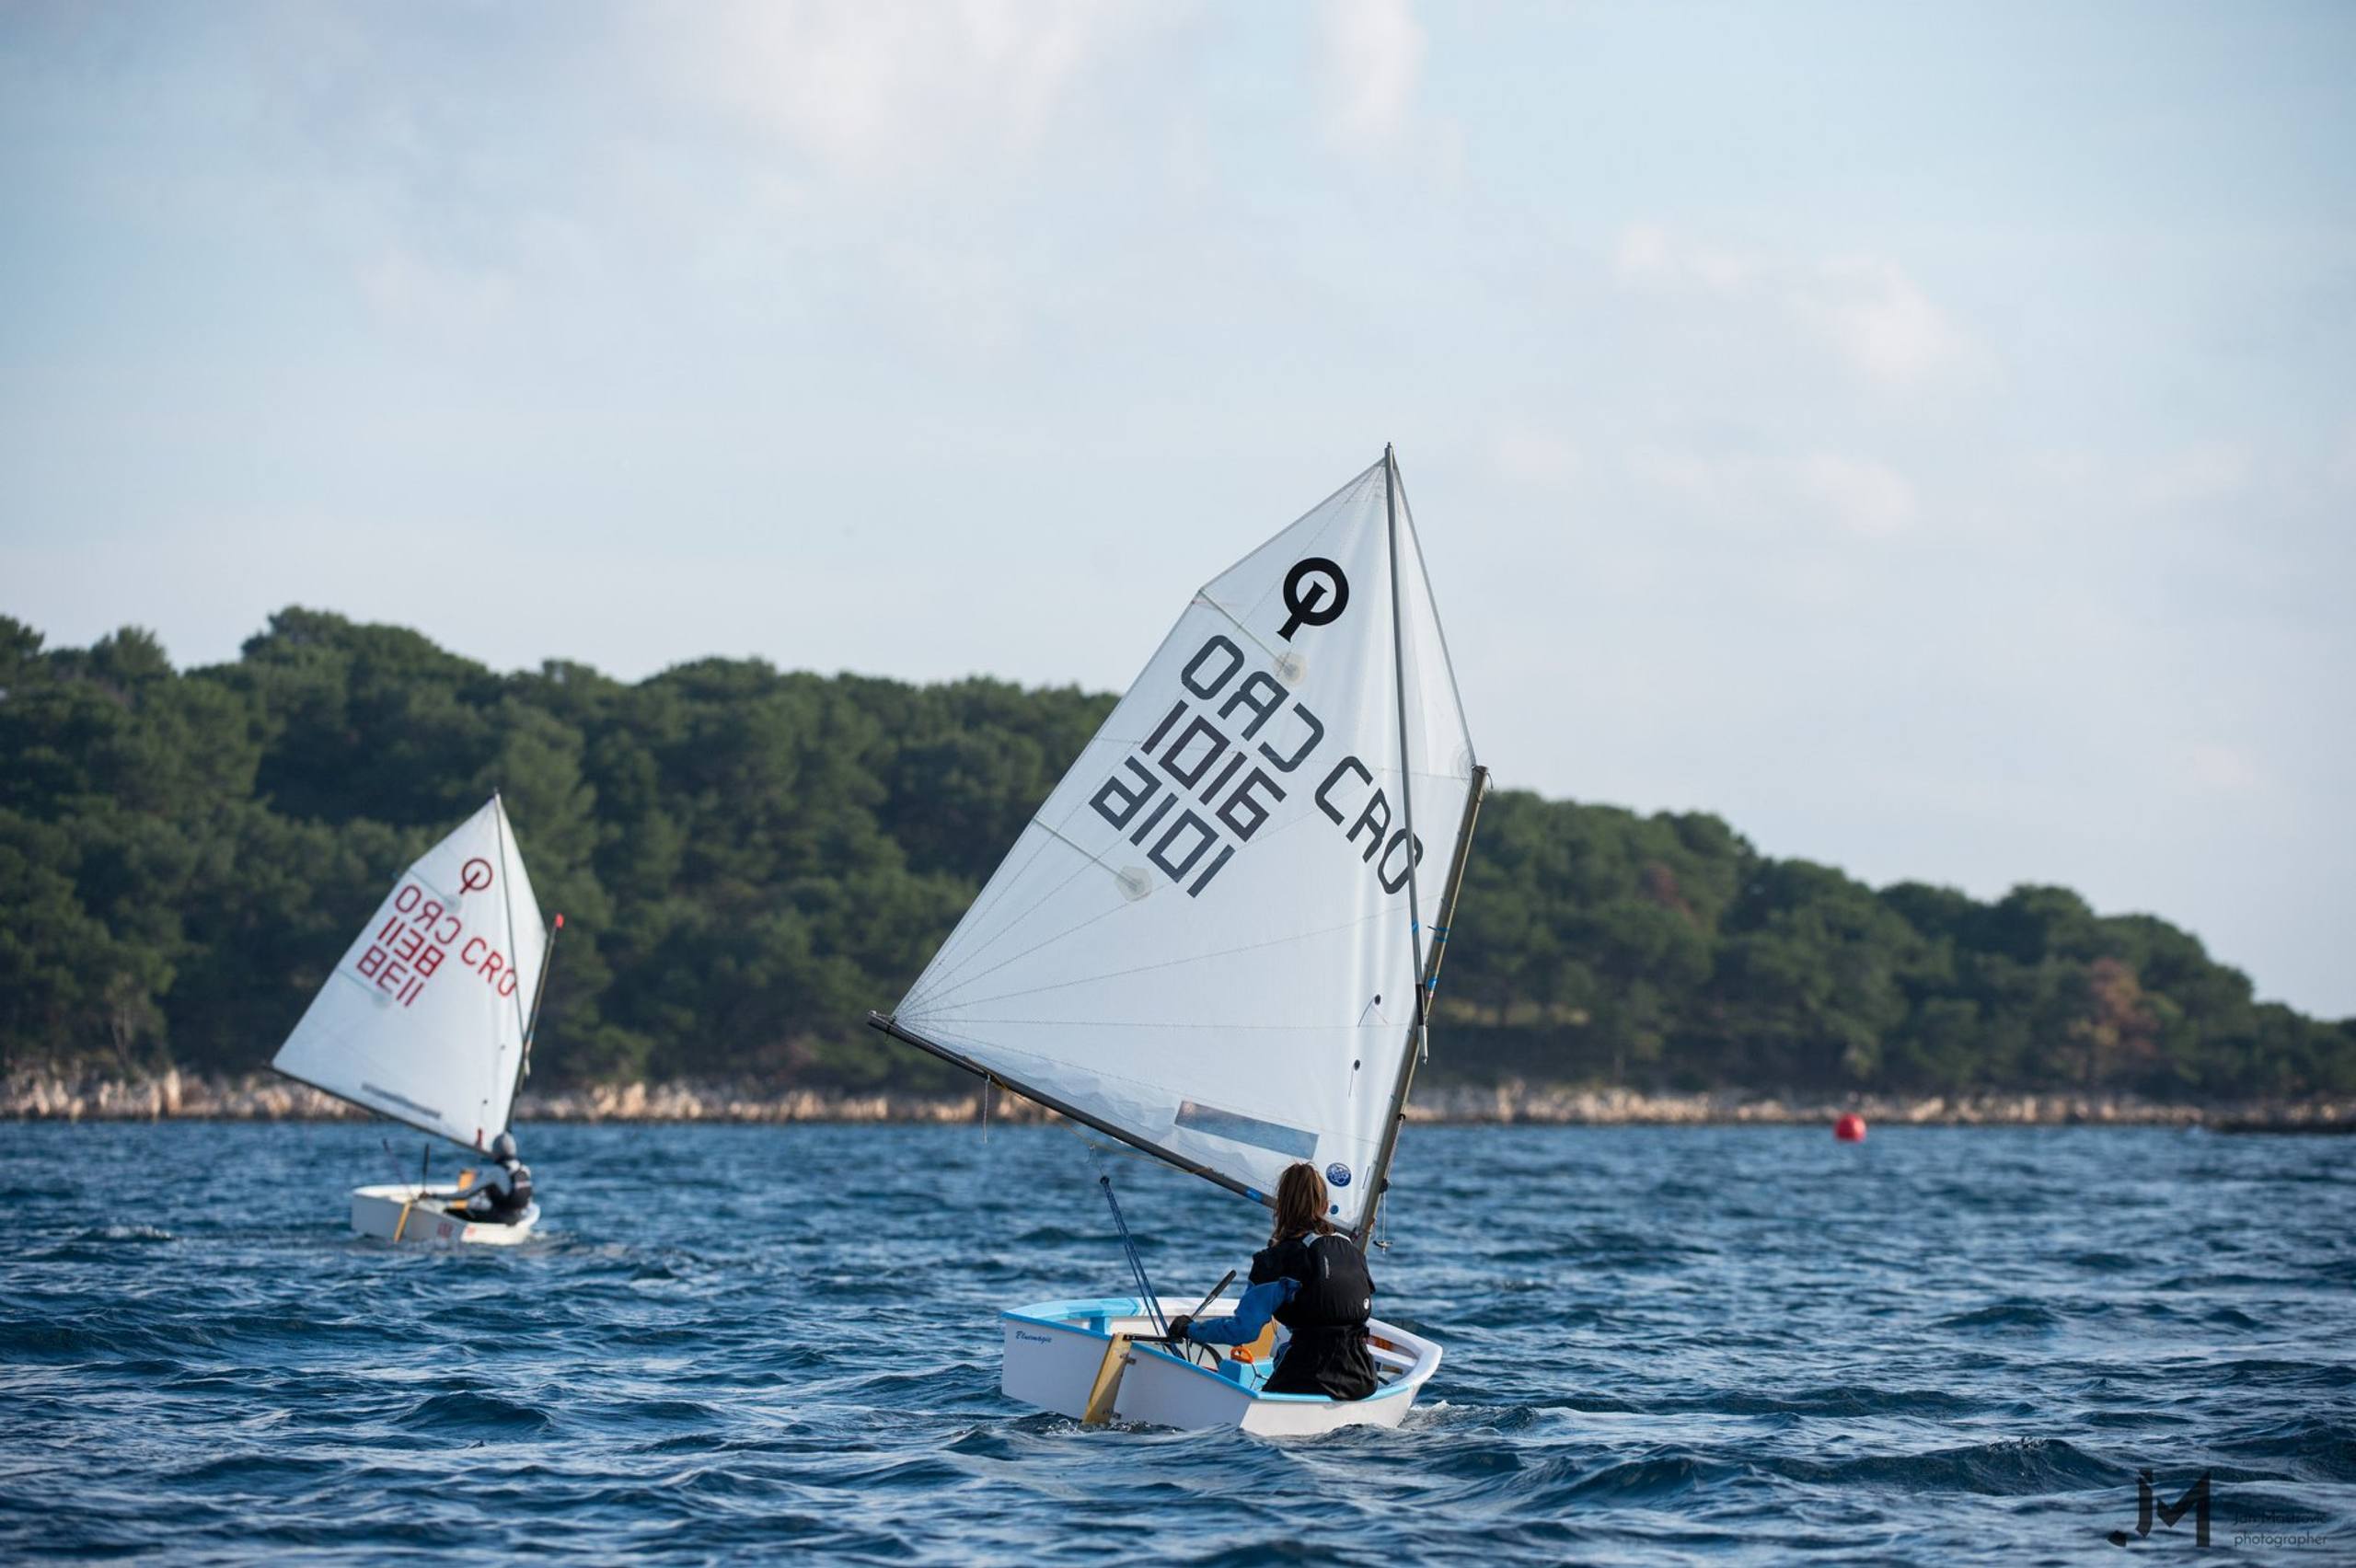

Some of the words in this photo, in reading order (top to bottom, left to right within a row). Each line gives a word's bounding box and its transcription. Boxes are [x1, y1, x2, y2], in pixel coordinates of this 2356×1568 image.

[1140, 699, 1288, 843] 1016
[1314, 755, 1424, 894] CRO
[461, 937, 517, 997] CRO
